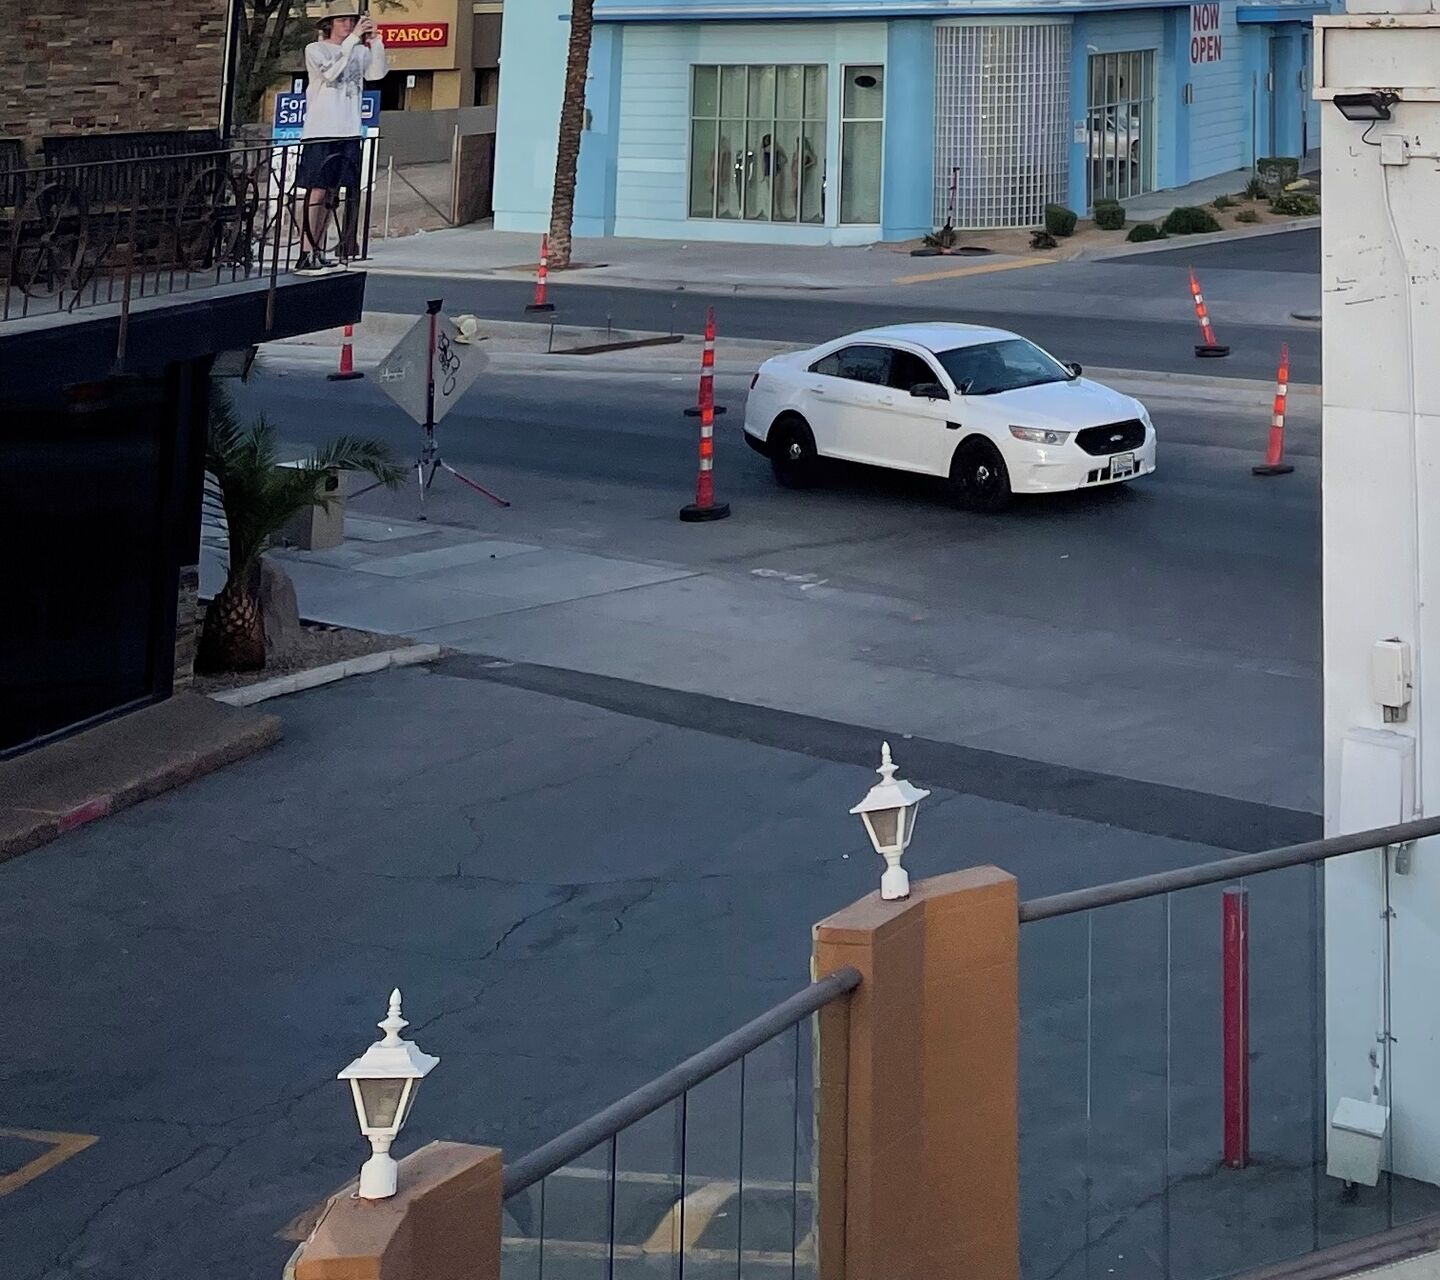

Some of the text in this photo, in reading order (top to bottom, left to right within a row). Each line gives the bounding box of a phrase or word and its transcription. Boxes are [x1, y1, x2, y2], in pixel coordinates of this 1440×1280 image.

[1193, 3, 1220, 32] NOW
[386, 27, 443, 42] FARGO
[1191, 35, 1222, 64] OPEN
[281, 97, 306, 111] For
